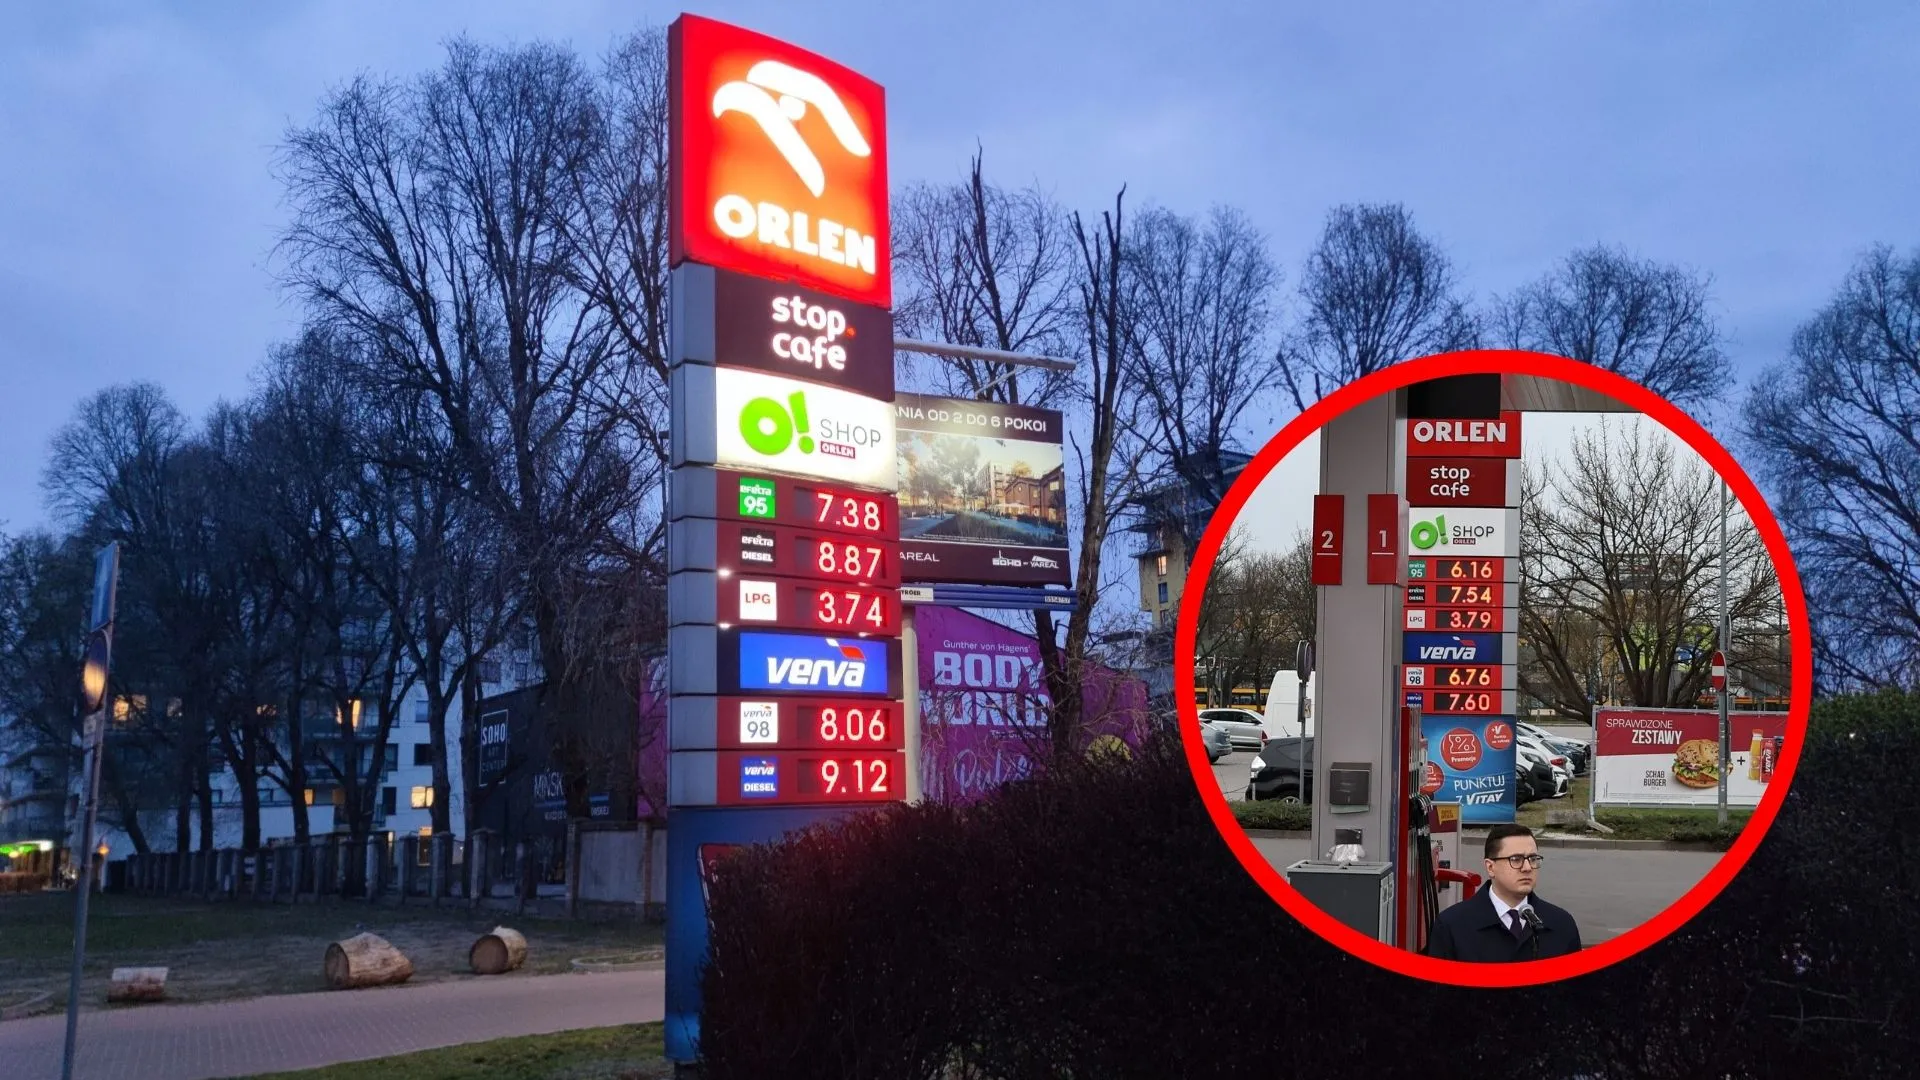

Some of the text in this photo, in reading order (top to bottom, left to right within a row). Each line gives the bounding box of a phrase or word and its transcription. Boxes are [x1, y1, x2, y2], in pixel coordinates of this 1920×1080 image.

[714, 194, 876, 275] ORLEN
[772, 332, 846, 370] cafe
[739, 391, 881, 456] O! SHOP
[928, 409, 948, 422] OD
[953, 413, 962, 424] 2
[967, 414, 986, 426] DO
[991, 415, 1000, 428] 6
[1005, 417, 1046, 432] POKOI
[1413, 421, 1506, 442] ORLEN
[821, 442, 854, 458] ORLEN
[1430, 482, 1470, 498] cafe
[744, 493, 880, 530] 95 7.38
[1321, 530, 1334, 549] 2
[1379, 530, 1387, 547] 1
[1410, 514, 1494, 549] O! SHOP
[742, 551, 773, 562] DIESEL
[818, 541, 881, 578] 8.87
[1031, 560, 1059, 569] YAREAL
[1411, 561, 1492, 578] 95 6.16
[1451, 586, 1491, 603] 7.54
[745, 591, 882, 627] LPG 3.74
[1450, 611, 1491, 628] 3.79
[943, 639, 977, 650] Gunther
[1420, 646, 1476, 660] verva
[767, 657, 865, 687] verva
[934, 651, 1043, 689] BODY
[1449, 668, 1490, 685] 6.76
[1409, 676, 1421, 684] 98
[1449, 693, 1490, 711] 7.60
[743, 709, 772, 717] verva
[747, 708, 885, 741] 98 8.06
[1606, 718, 1673, 729] SPRAWDZONE
[482, 723, 506, 745] SOHO
[1631, 729, 1682, 745] ZESTAWY
[745, 760, 887, 793] verva 9.12
[1643, 778, 1666, 787] BURGER
[1645, 770, 1665, 778] SCHAB
[744, 783, 775, 792] DIESEL
[1454, 775, 1505, 791] PUNKTUJ
[1466, 789, 1505, 805] VITAY
